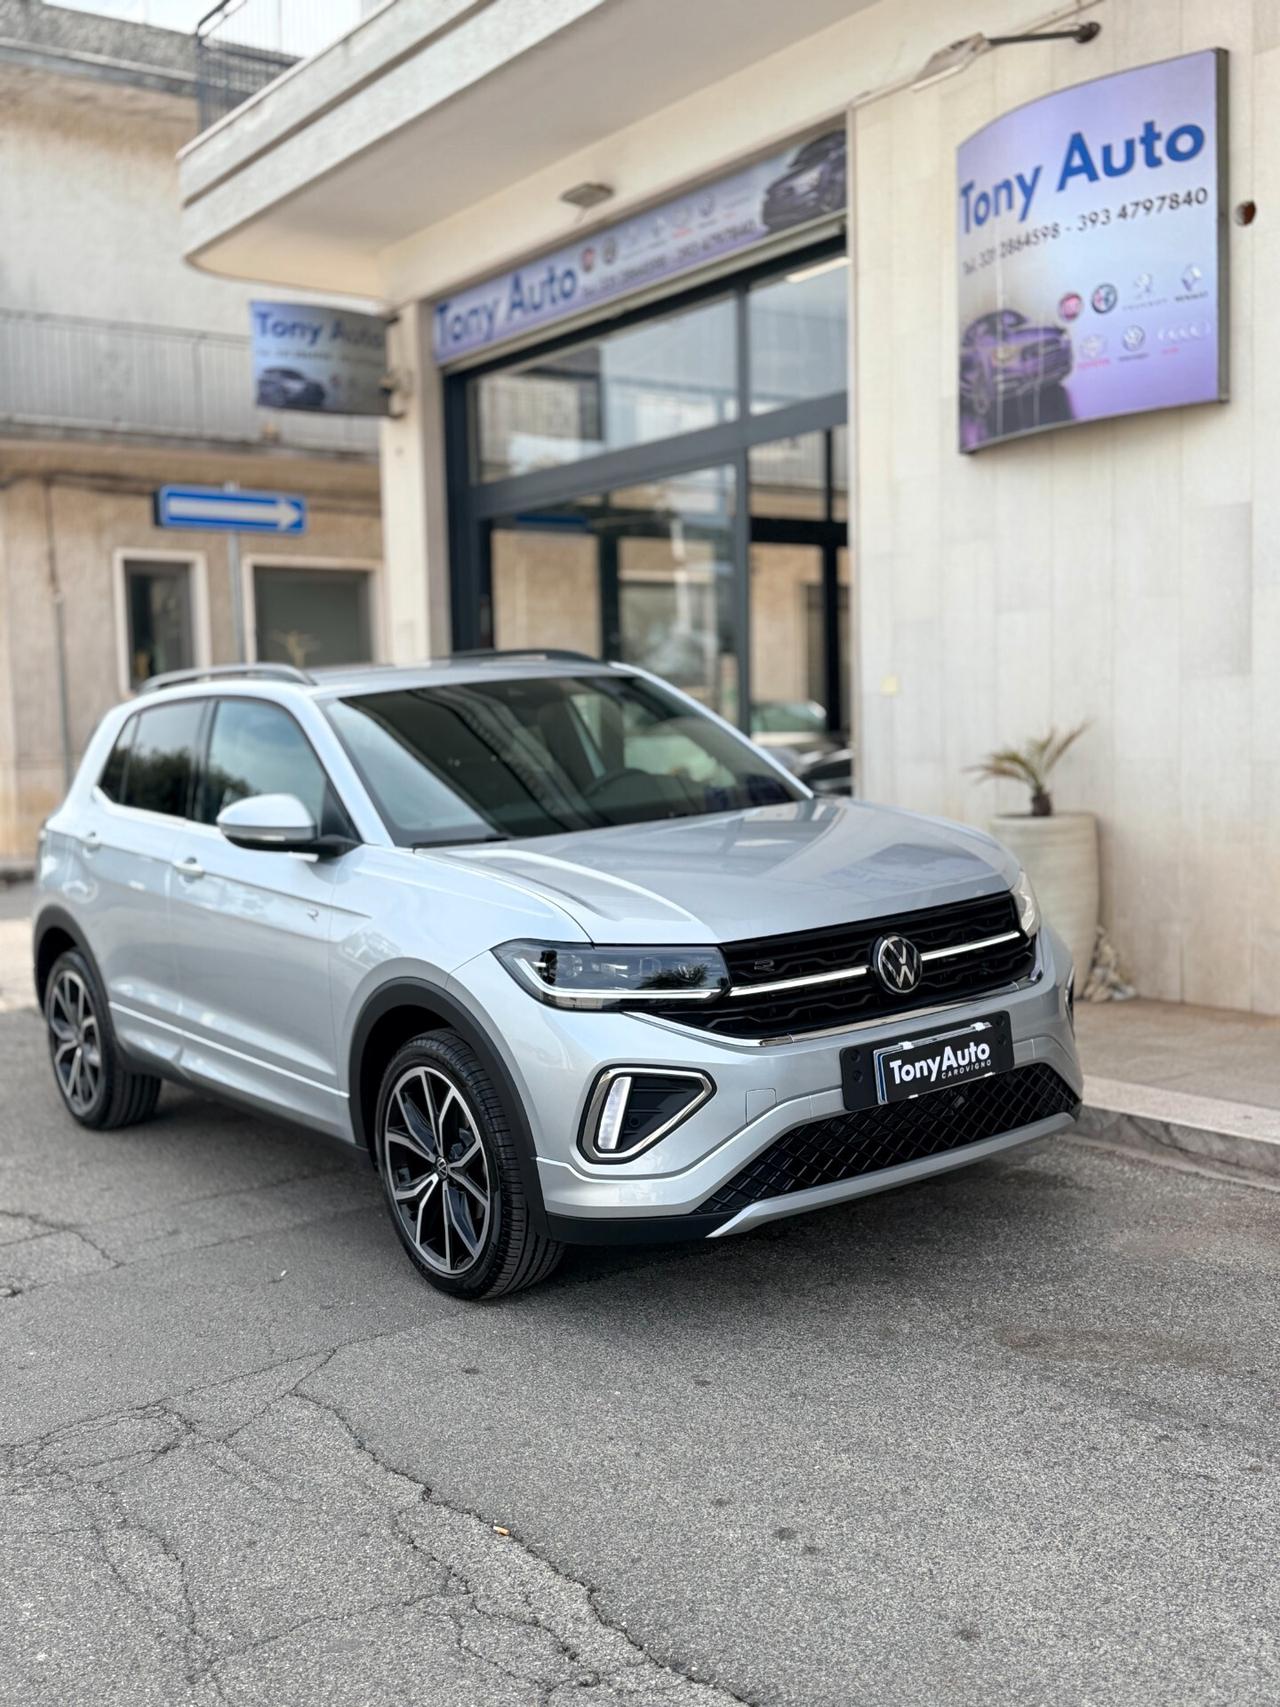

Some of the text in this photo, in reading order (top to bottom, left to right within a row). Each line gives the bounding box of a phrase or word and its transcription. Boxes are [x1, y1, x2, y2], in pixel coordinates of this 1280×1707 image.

[960, 120, 1205, 235] Tony Auto
[1077, 208, 1111, 232] 393
[1117, 187, 1208, 221] 4797840
[435, 264, 577, 347] Tony Auto
[256, 312, 322, 345] Tony
[941, 1061, 992, 1079] CAROVIGNO
